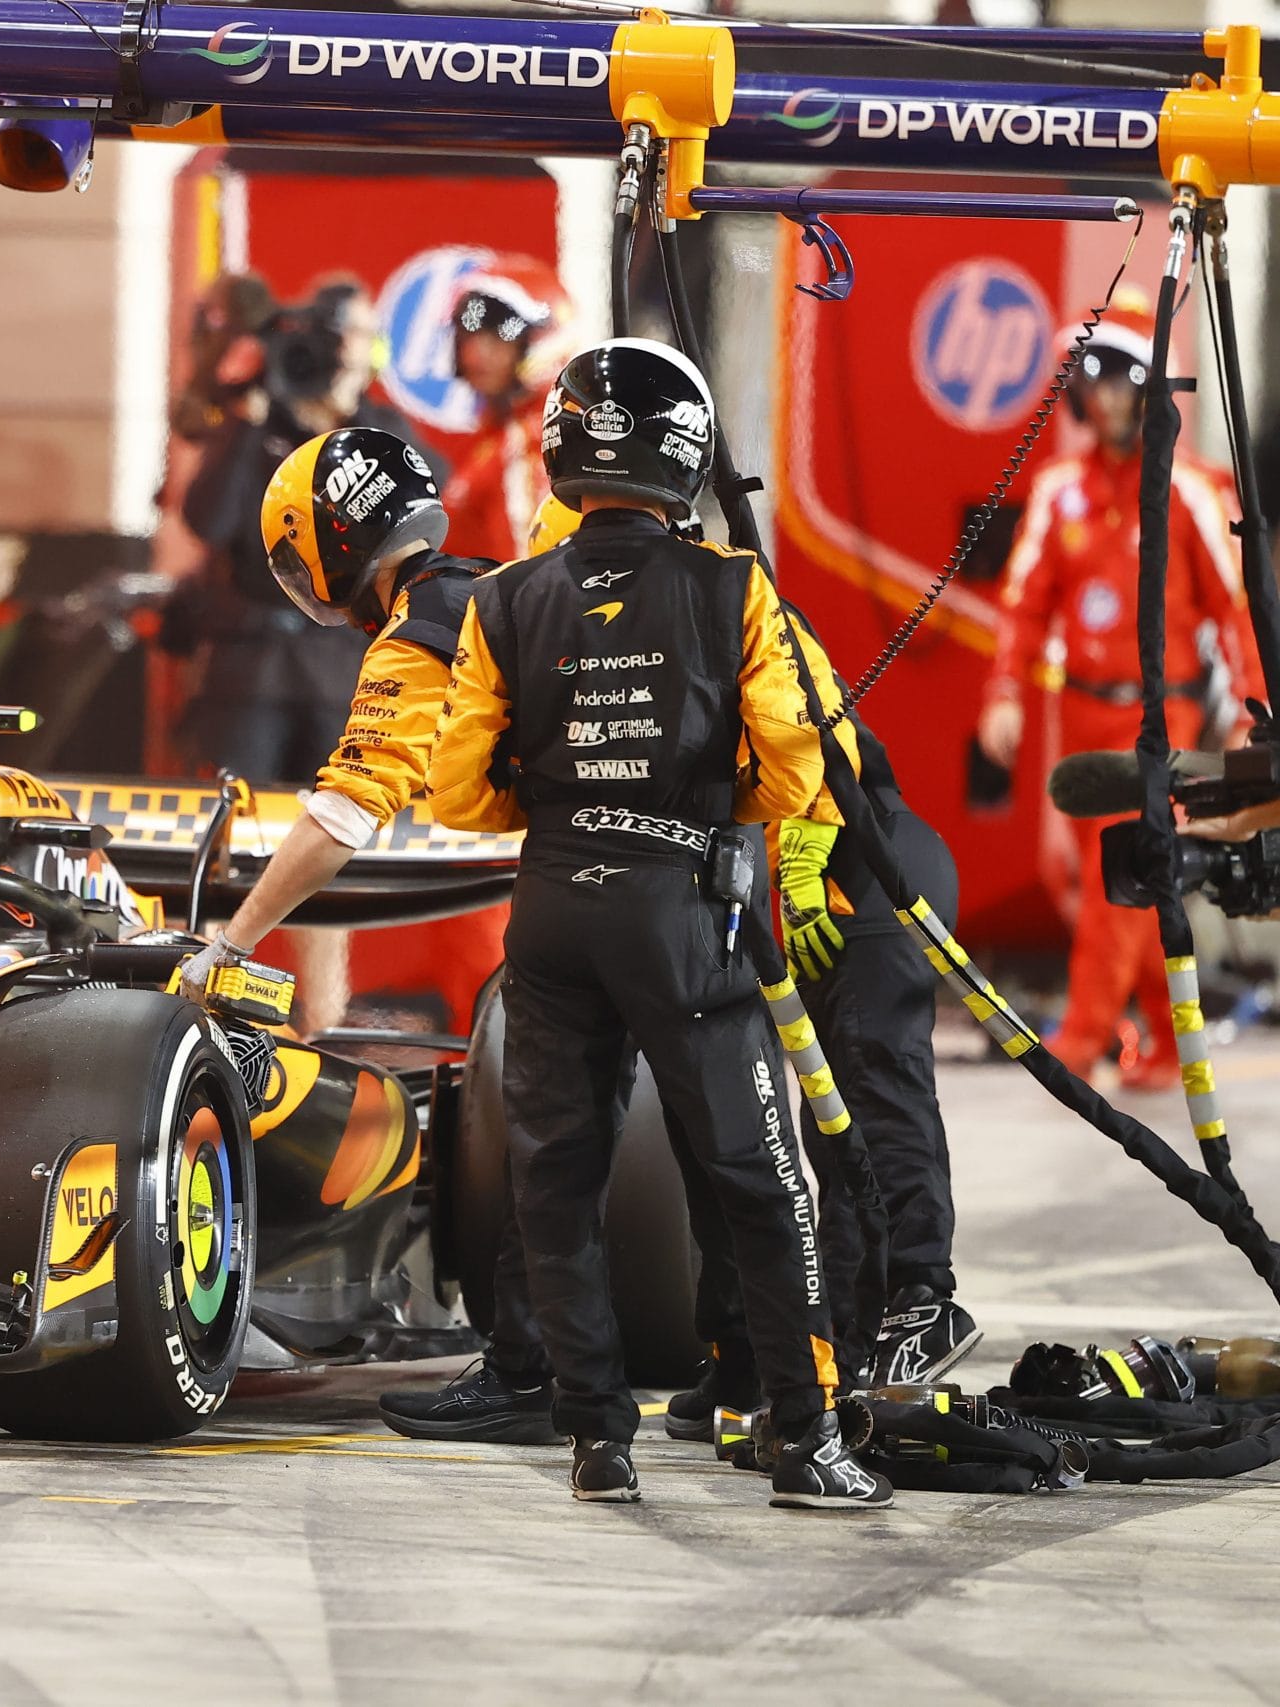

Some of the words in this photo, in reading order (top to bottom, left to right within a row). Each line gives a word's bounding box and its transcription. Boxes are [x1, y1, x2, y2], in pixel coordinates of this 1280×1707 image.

[288, 37, 370, 77] DP
[383, 38, 609, 89] WORLD
[858, 100, 936, 140] DP
[937, 101, 1157, 150] WORLD
[936, 263, 1036, 426] hp
[590, 411, 625, 422] Estrella
[591, 420, 623, 432] Galicia
[670, 400, 710, 443] ON
[659, 443, 701, 471] NUTRITION
[663, 433, 703, 459] OPTIMUM
[325, 448, 379, 504] ON
[346, 471, 393, 516] OPTIMUM
[353, 480, 397, 523] NUTRITION
[580, 657, 600, 672] DP
[602, 652, 665, 671] WORLD
[354, 703, 397, 720] alteryx
[573, 687, 626, 707] Android
[565, 720, 608, 747] ON
[607, 718, 655, 732] OPTIMUM
[608, 727, 663, 741] NUTRITION
[572, 806, 708, 852] alpinestars
[752, 1060, 776, 1106] ON
[765, 1106, 801, 1192] OPTIMUM
[61, 1186, 115, 1227] VELO
[793, 1193, 821, 1306] NUTRITION
[166, 1334, 217, 1415] ZERO
